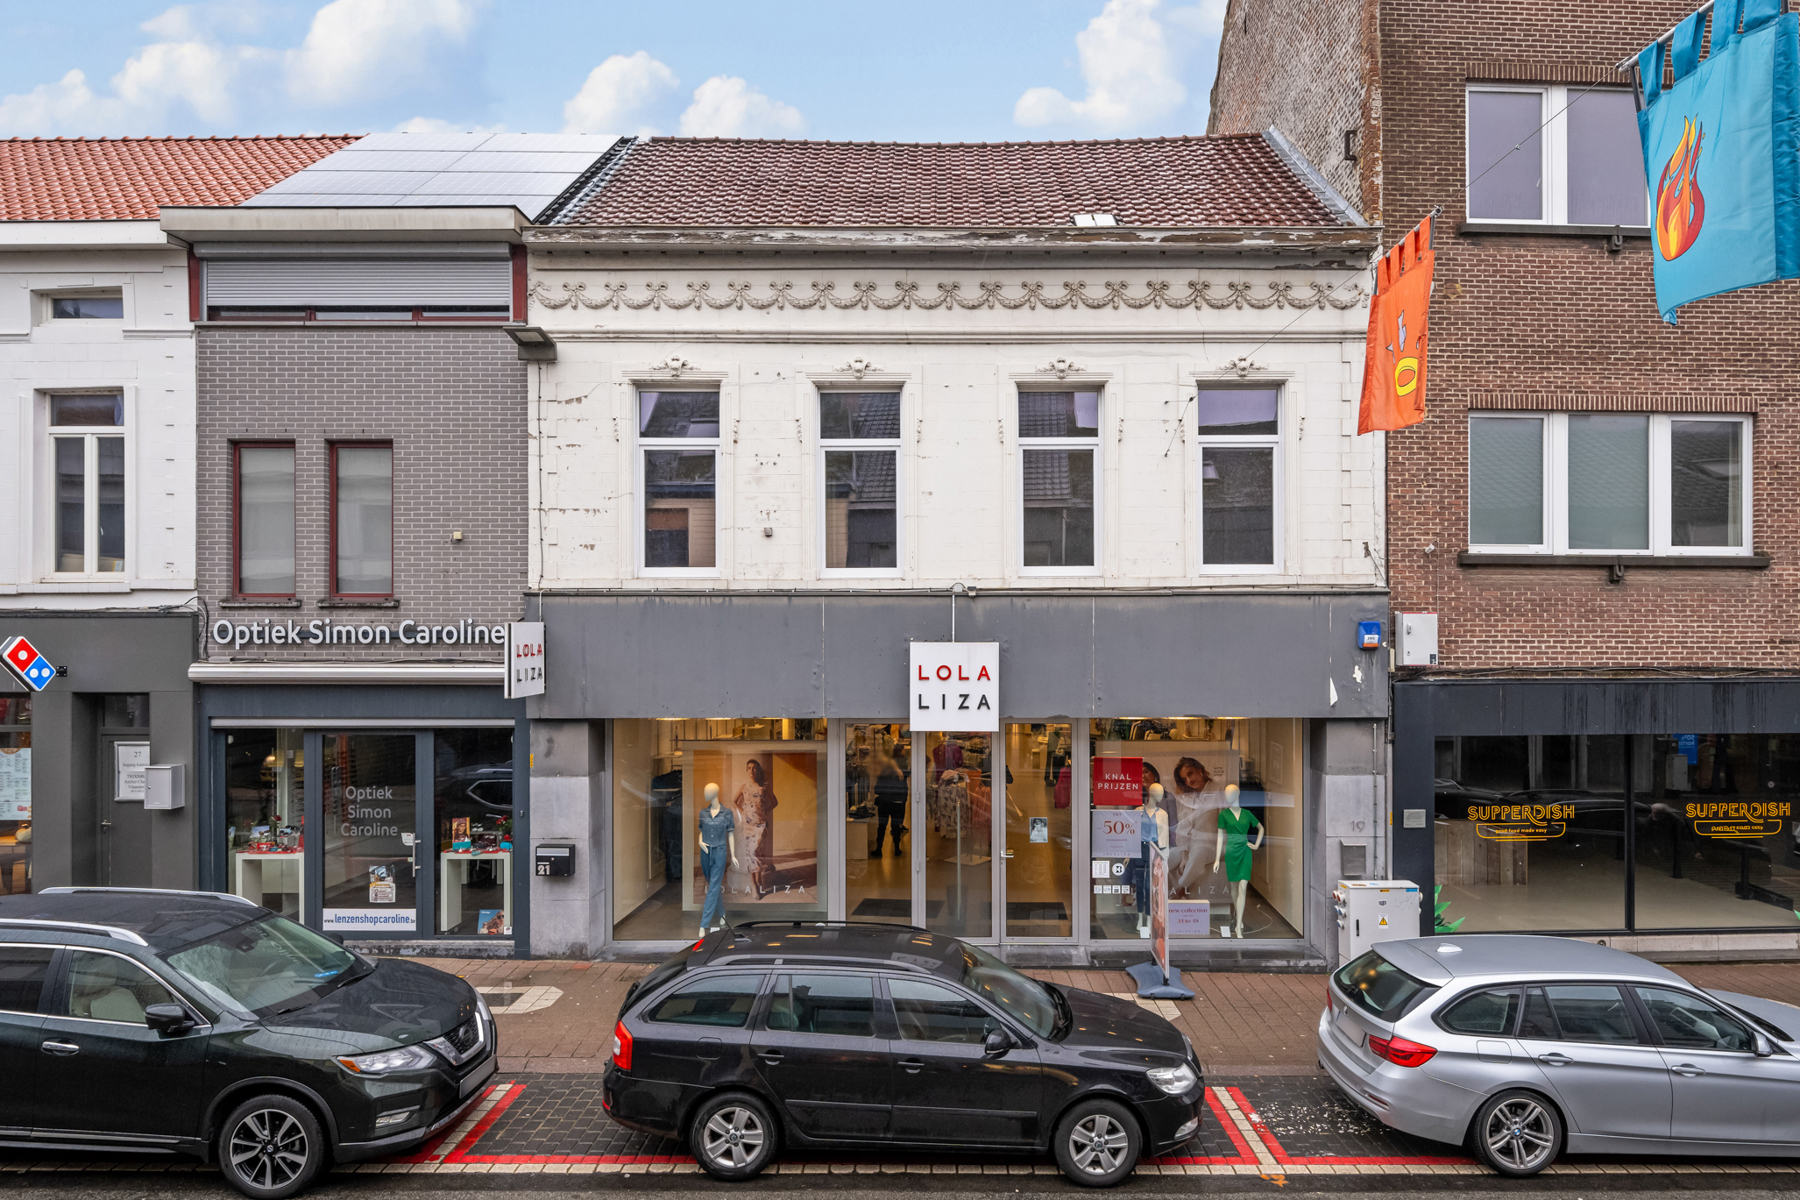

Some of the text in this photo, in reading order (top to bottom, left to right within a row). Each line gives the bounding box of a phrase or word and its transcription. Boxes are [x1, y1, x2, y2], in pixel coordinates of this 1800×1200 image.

[213, 618, 505, 650] Optiek Simon Caroline
[516, 643, 544, 658] LOLA
[516, 667, 544, 683] LIZA
[918, 664, 991, 681] LOLA
[918, 693, 991, 710] LIZA
[1105, 773, 1132, 781] KNAL
[1097, 782, 1139, 790] PRIJZEN
[345, 786, 393, 802] Optiek
[347, 805, 391, 818] Simon
[1467, 804, 1575, 826] SUPPERDISH
[1686, 802, 1791, 823] SUPPERDISH
[341, 823, 398, 836] Caroline
[1350, 820, 1366, 832] 19
[538, 864, 550, 876] 21
